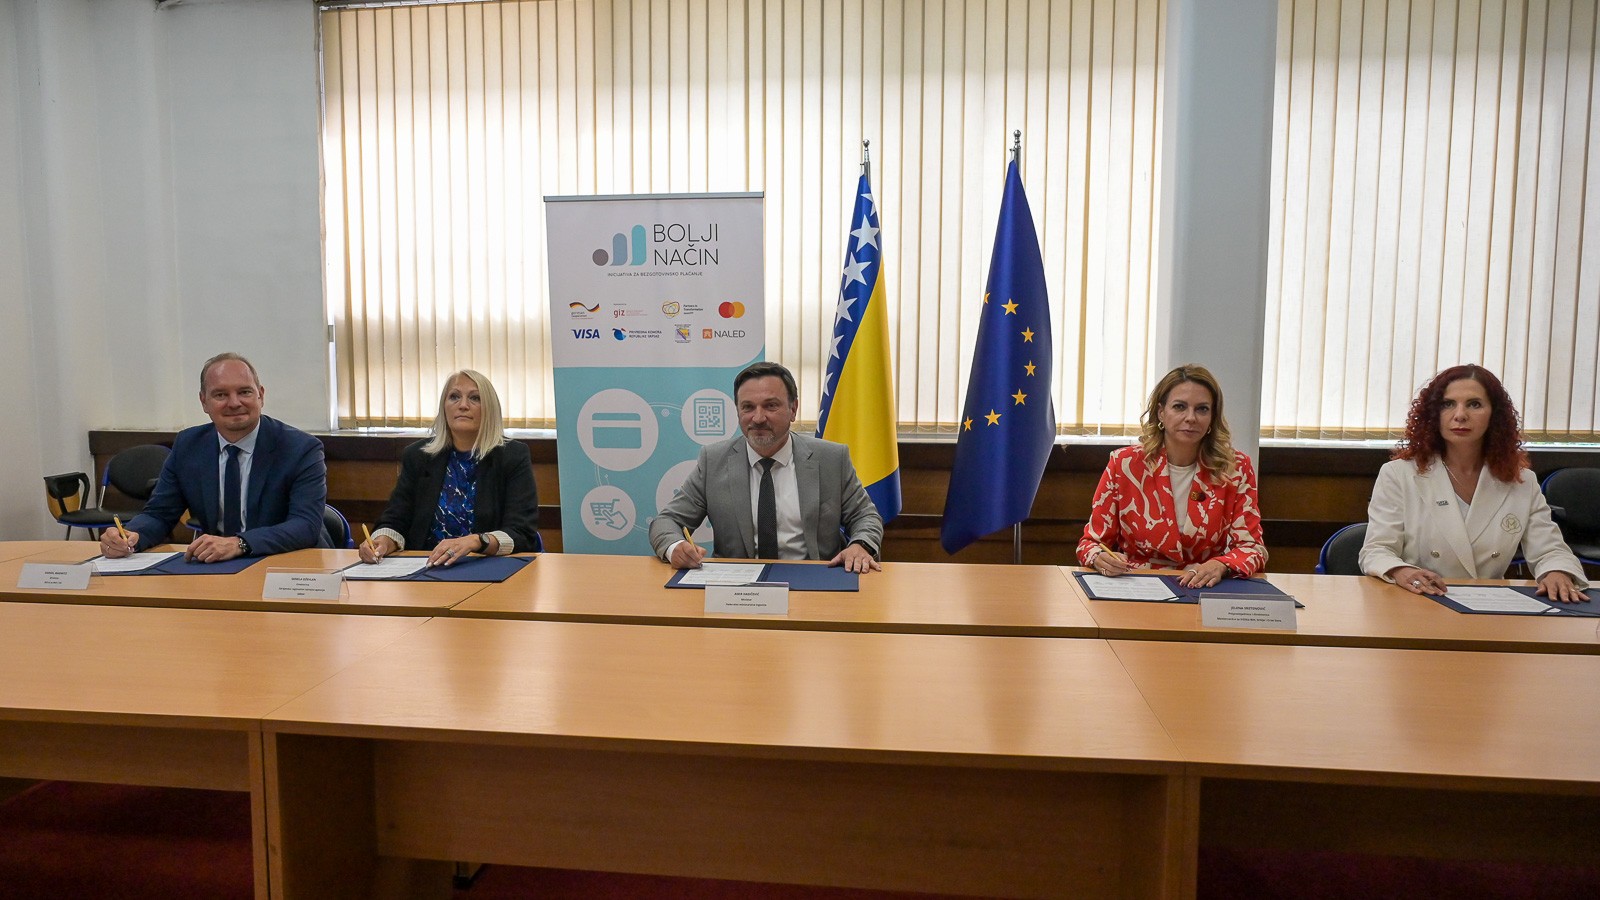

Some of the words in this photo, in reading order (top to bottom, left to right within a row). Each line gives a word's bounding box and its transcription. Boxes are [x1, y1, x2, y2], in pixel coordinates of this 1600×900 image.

[653, 223, 718, 243] BOLJI
[654, 243, 719, 266] NAČIN
[613, 309, 625, 318] giz
[571, 329, 600, 339] VISA
[714, 330, 746, 338] NALED
